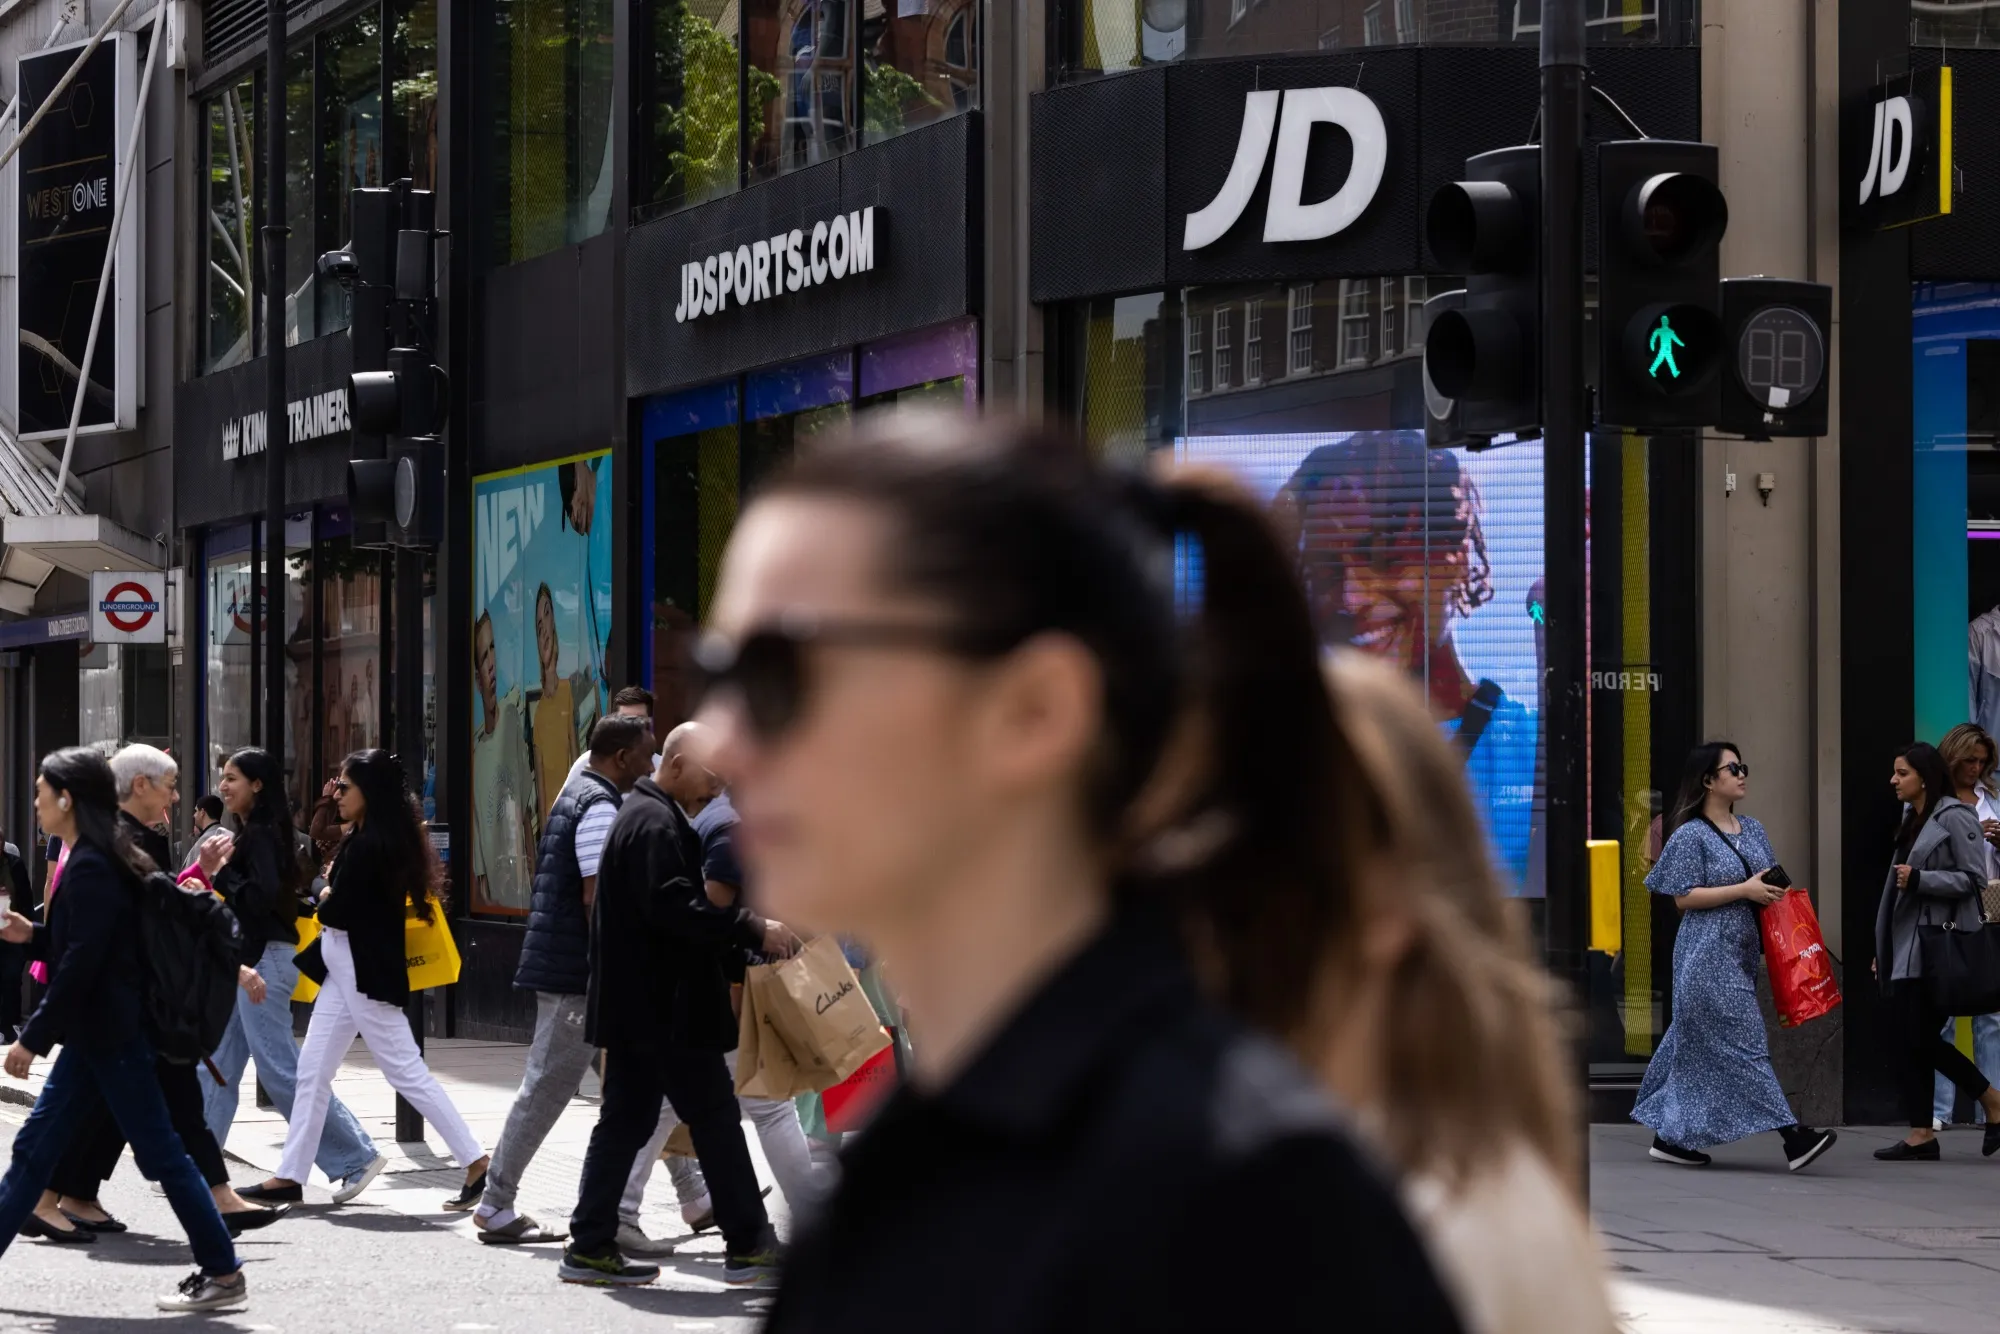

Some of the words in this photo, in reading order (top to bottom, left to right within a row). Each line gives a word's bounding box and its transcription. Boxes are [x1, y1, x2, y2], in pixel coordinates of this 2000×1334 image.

[1183, 86, 1388, 251] JD
[1859, 96, 1913, 206] JD
[675, 206, 875, 324] JDSPORTS.COM
[242, 409, 267, 457] KIN
[477, 483, 545, 619] NEW
[102, 603, 156, 611] UNDERGROUND
[815, 978, 854, 1015] Clarks
